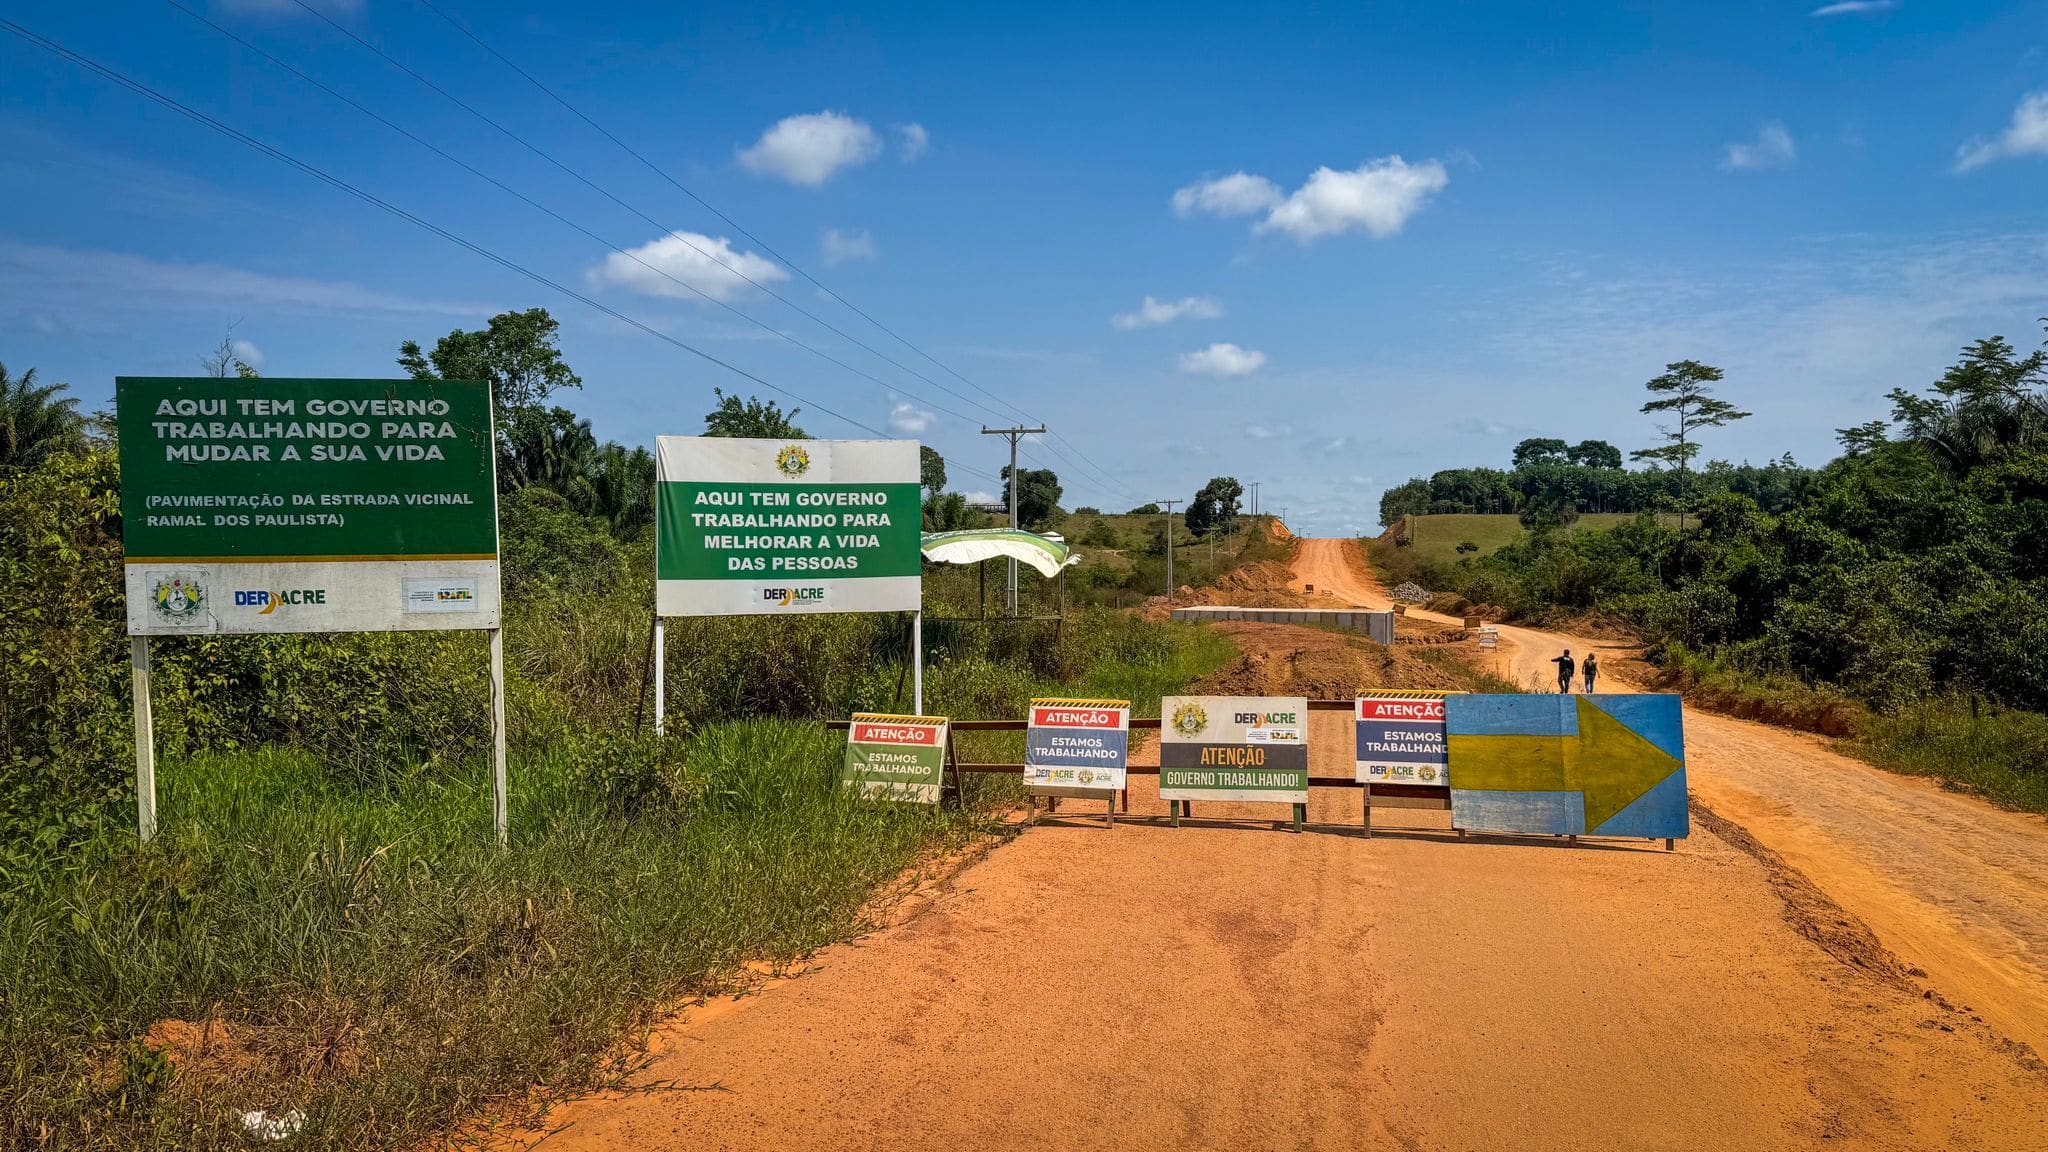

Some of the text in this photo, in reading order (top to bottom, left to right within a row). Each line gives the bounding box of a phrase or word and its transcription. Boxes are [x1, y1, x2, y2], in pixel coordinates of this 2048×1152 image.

[156, 398, 449, 417] AQUI TEM GOVERNO
[152, 421, 457, 439] TRABALHANDO PARA
[166, 444, 445, 462] MUDAR A SUA VIDA
[145, 493, 474, 509] (PAVIMENTAÇÃO DA ESTRADA VICINAL
[694, 491, 888, 507] AQUI TEM GOVERNO
[147, 513, 345, 528] RAMAL DOS PAULISTA)
[691, 513, 891, 528] TRABALHANDO PARA
[704, 534, 880, 549] MELHORAR A VIDA
[728, 556, 858, 571] DAS PESSOAS
[1046, 710, 1109, 726] ATENÇÃO
[1375, 702, 1445, 719] ATENÇÃO
[865, 727, 925, 743] ATENÇÃO
[1051, 737, 1103, 748] ESTAMOS
[1384, 731, 1442, 742] ESTAMOS
[1035, 747, 1118, 759] TRABALHANDO
[1366, 742, 1448, 753] TRABALHAND
[868, 752, 918, 764] ESTAMOS
[1200, 744, 1265, 768] ATENÇÃO
[852, 762, 932, 775] TRABALHANDO
[1167, 771, 1299, 787] GOVERNO TRABALHANDO!
